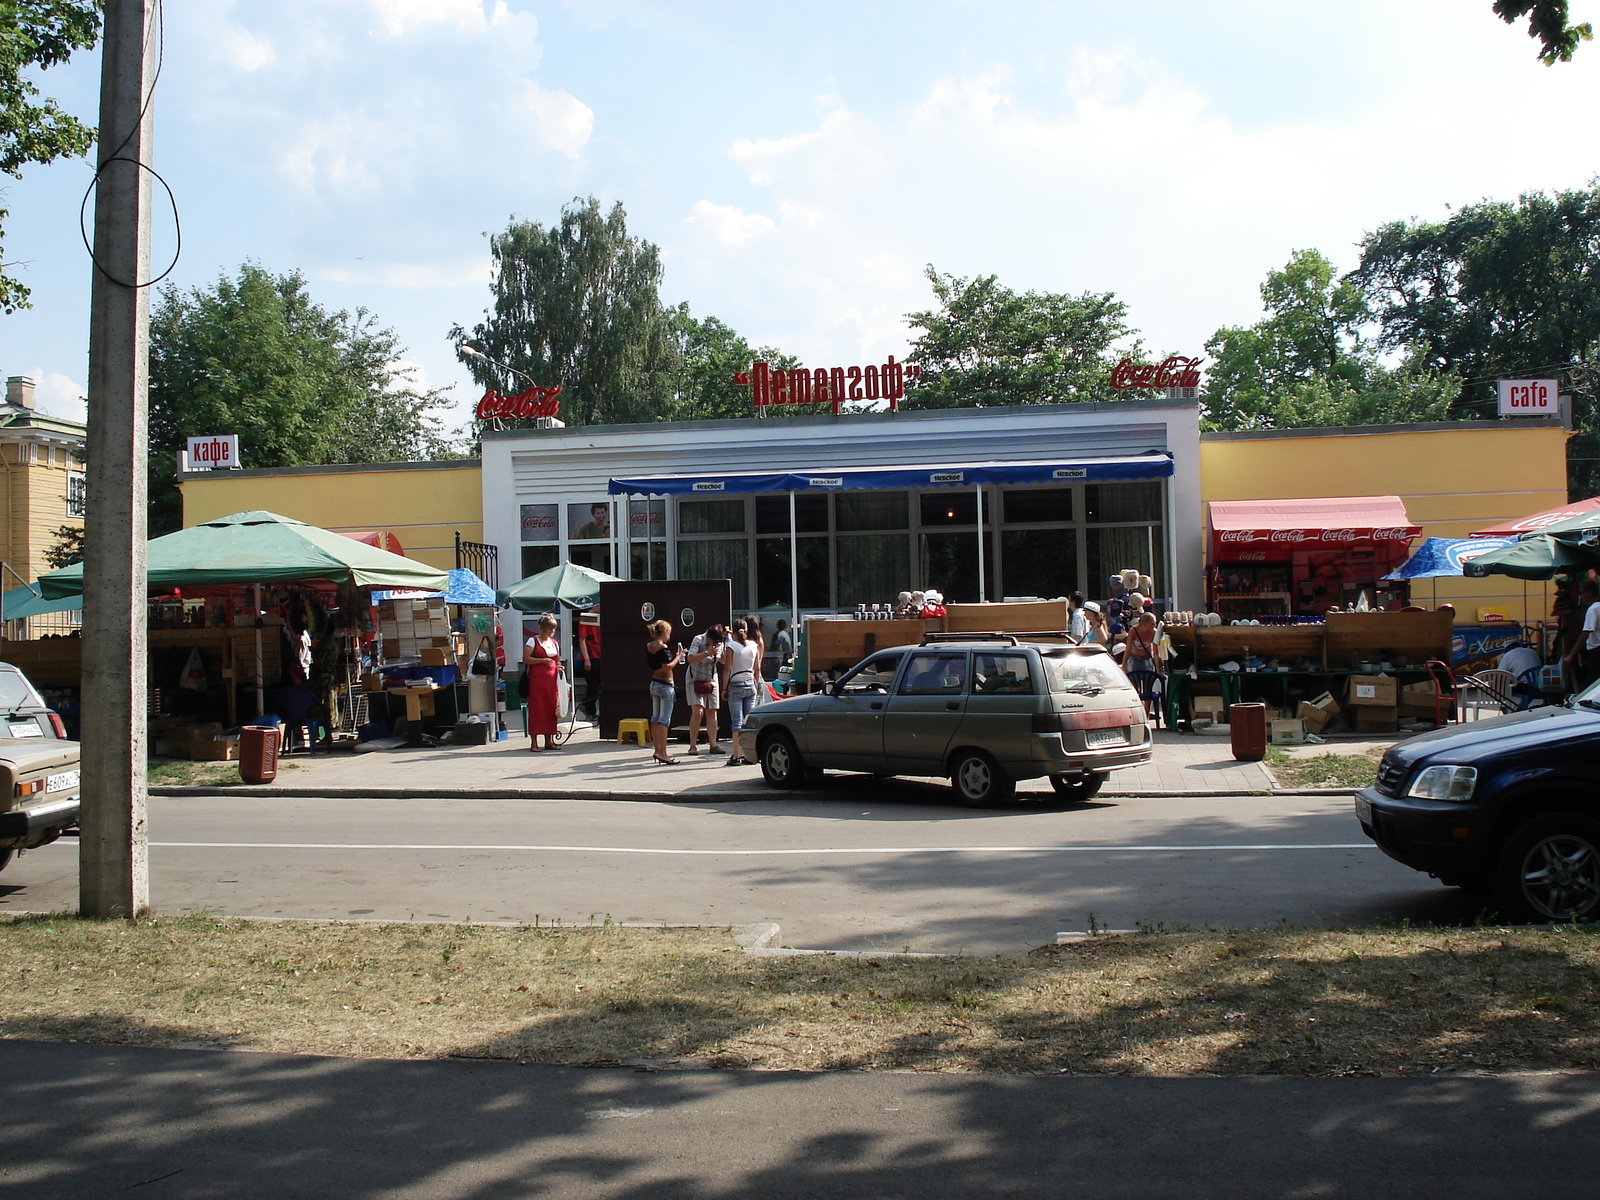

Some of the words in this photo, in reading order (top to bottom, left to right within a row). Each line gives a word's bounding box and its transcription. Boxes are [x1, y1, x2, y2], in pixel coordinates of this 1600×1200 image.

[1110, 356, 1206, 390] Coca-Cola
[476, 386, 564, 420] Coca-Cola
[1510, 381, 1547, 407] cafe
[193, 437, 229, 467] кафе
[1220, 529, 1254, 542] Coca-Cola
[1271, 528, 1305, 542] Coca-Cola
[1321, 528, 1356, 542] Coca-Cola
